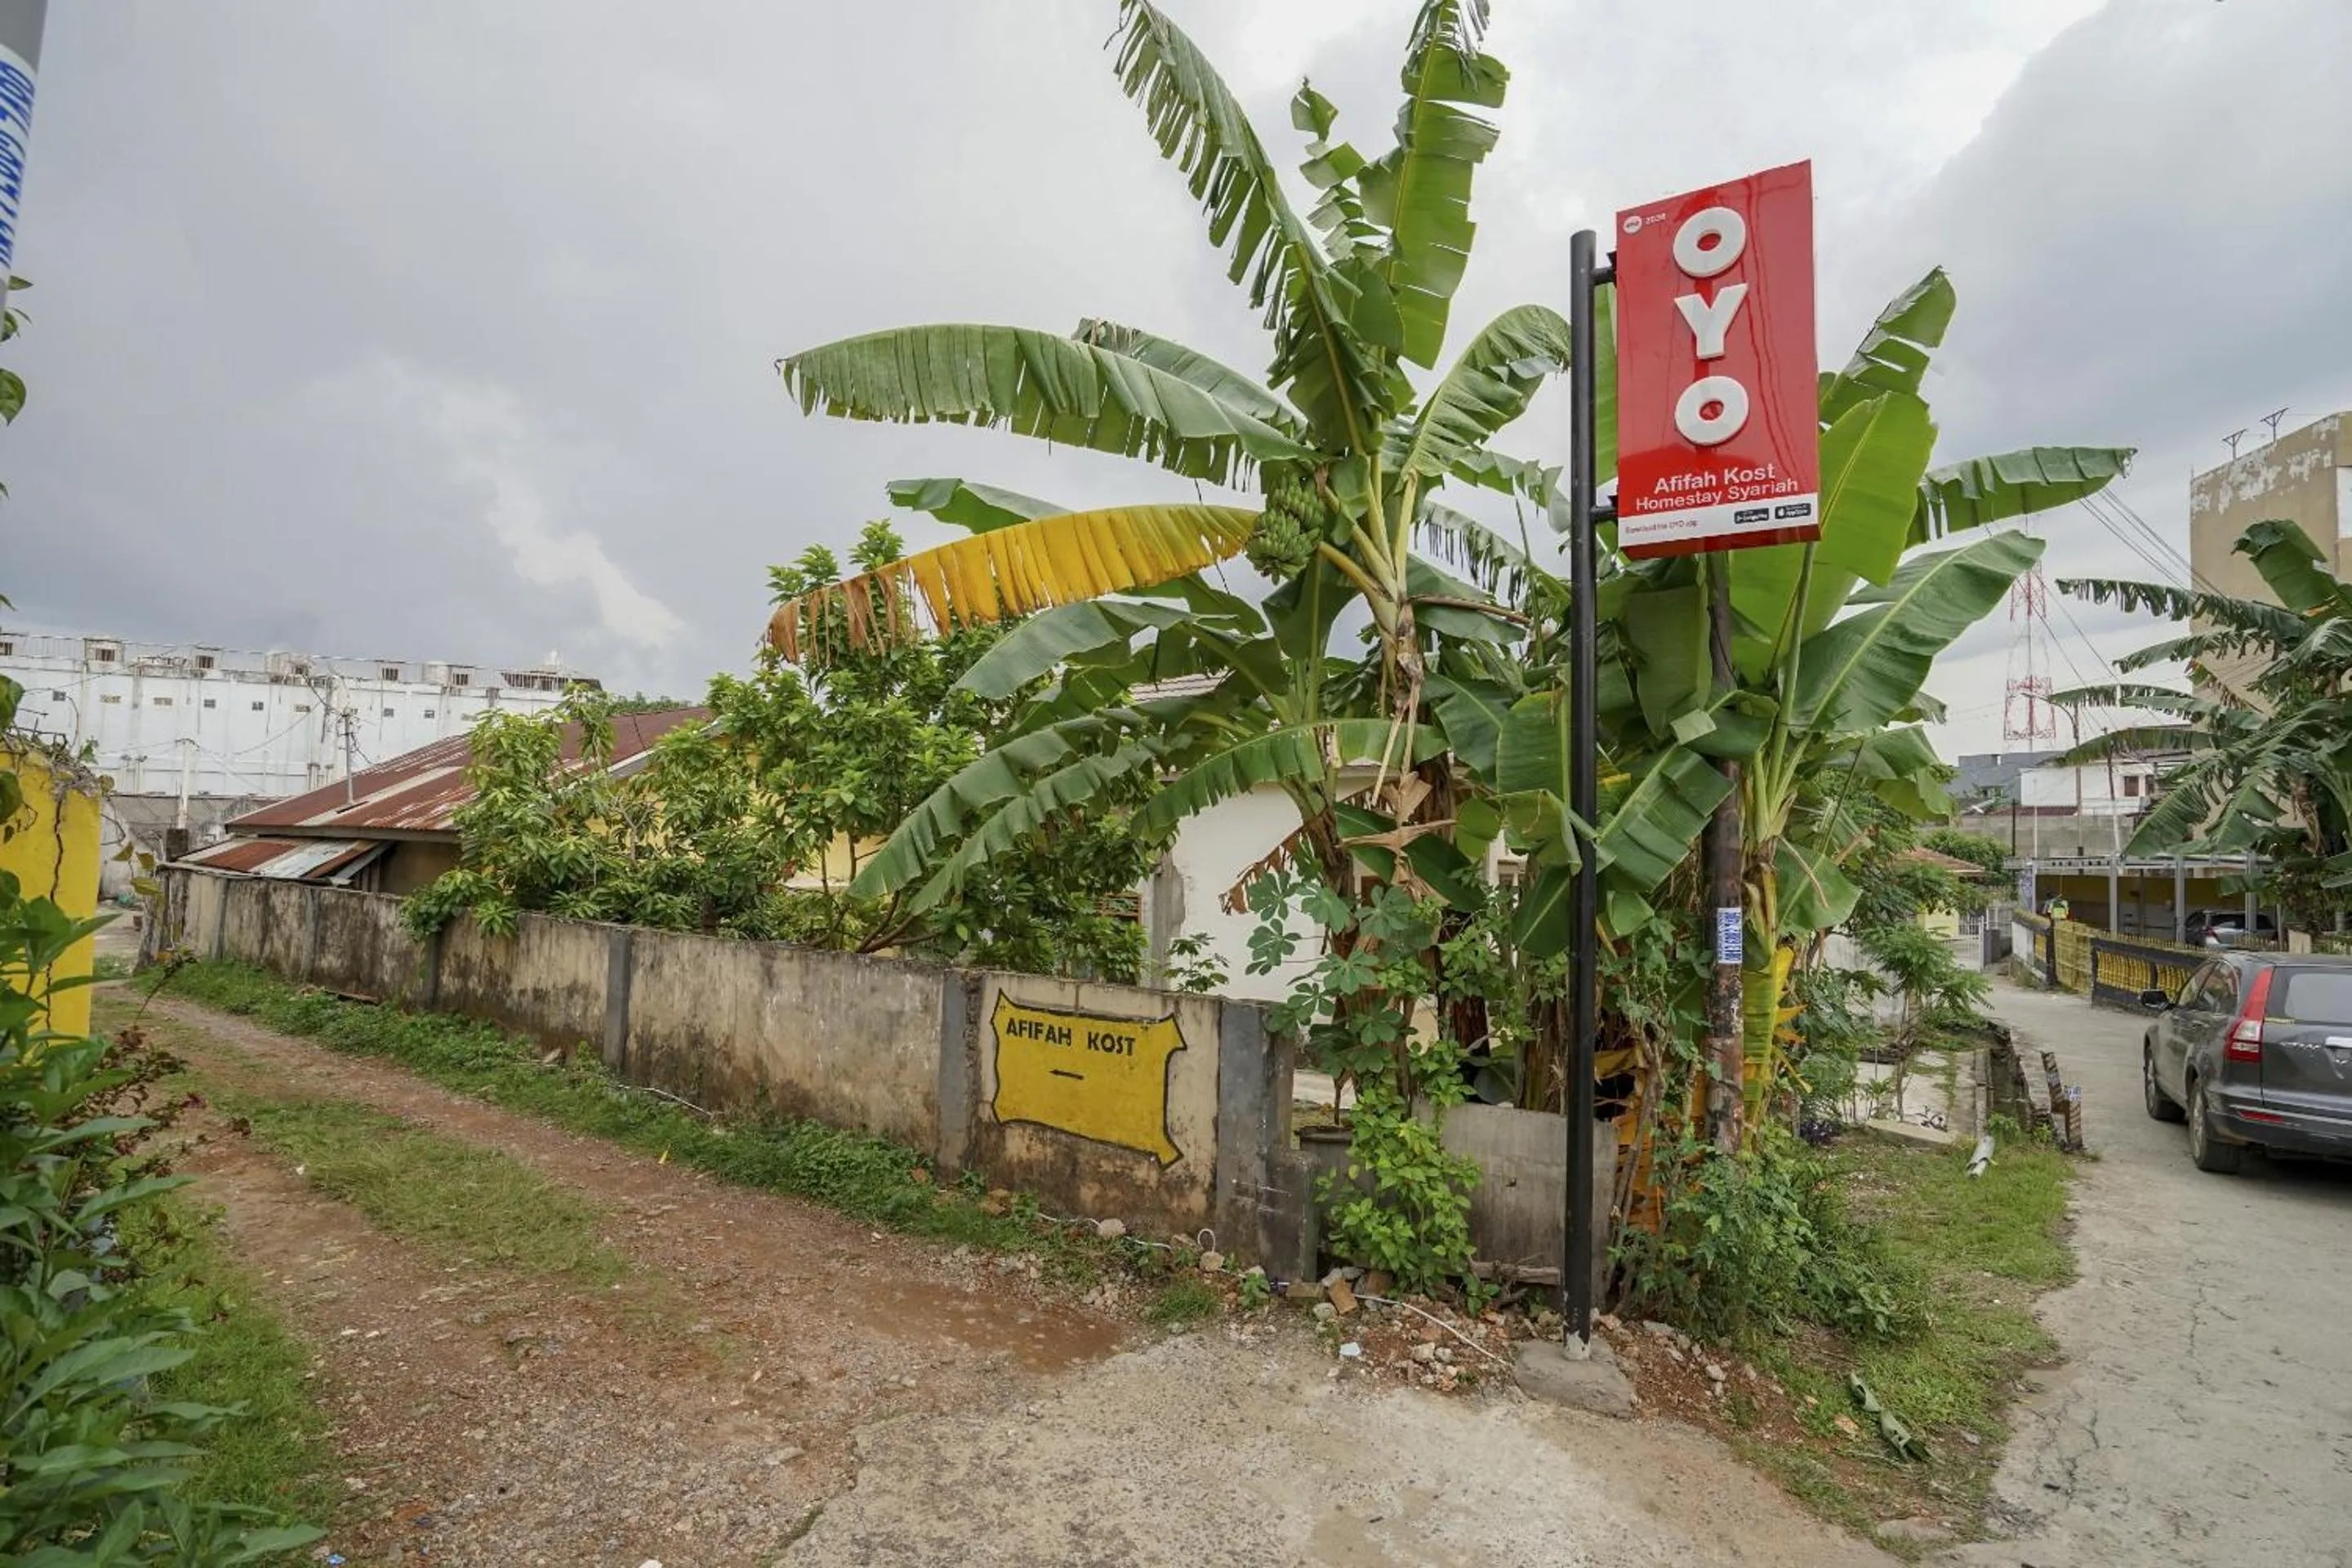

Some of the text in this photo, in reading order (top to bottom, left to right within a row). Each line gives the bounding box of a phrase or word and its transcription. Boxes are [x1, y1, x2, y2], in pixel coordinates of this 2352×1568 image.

[1673, 207, 1748, 446] OYO
[1637, 479, 1798, 511] Homestay Syariah
[1655, 463, 1775, 494] Afifah Kost
[1005, 1018, 1136, 1056] AFIFAH KOST
